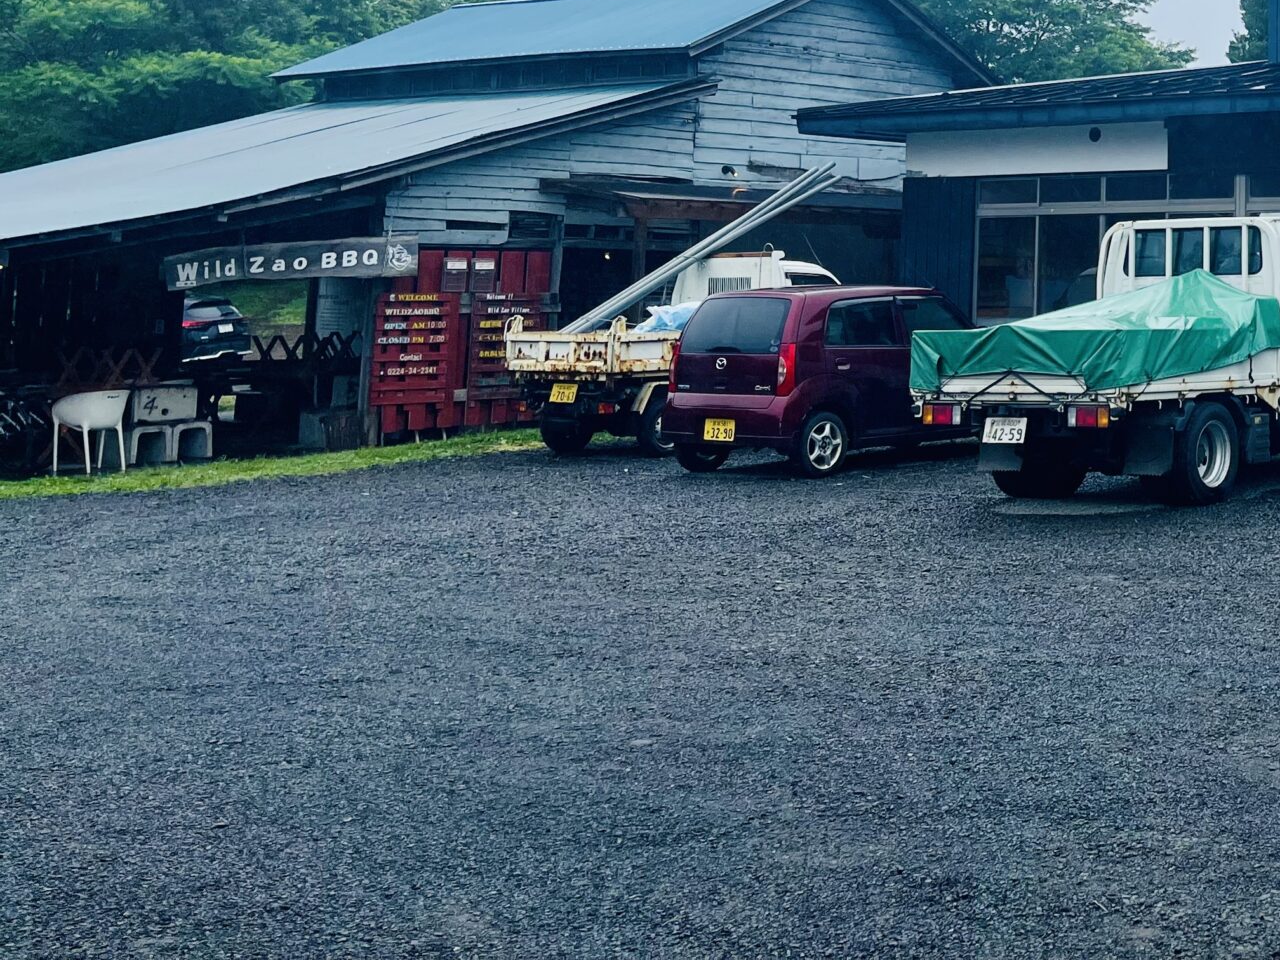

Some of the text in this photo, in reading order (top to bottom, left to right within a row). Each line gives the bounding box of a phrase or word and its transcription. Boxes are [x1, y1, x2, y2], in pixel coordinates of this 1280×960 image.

[176, 249, 379, 283] Wild Zao BBQ
[398, 293, 439, 301] WELCOME
[384, 322, 407, 330] OPEN
[377, 336, 410, 344] CLOSED
[399, 353, 422, 361] Contact
[991, 428, 1023, 441] 42-59
